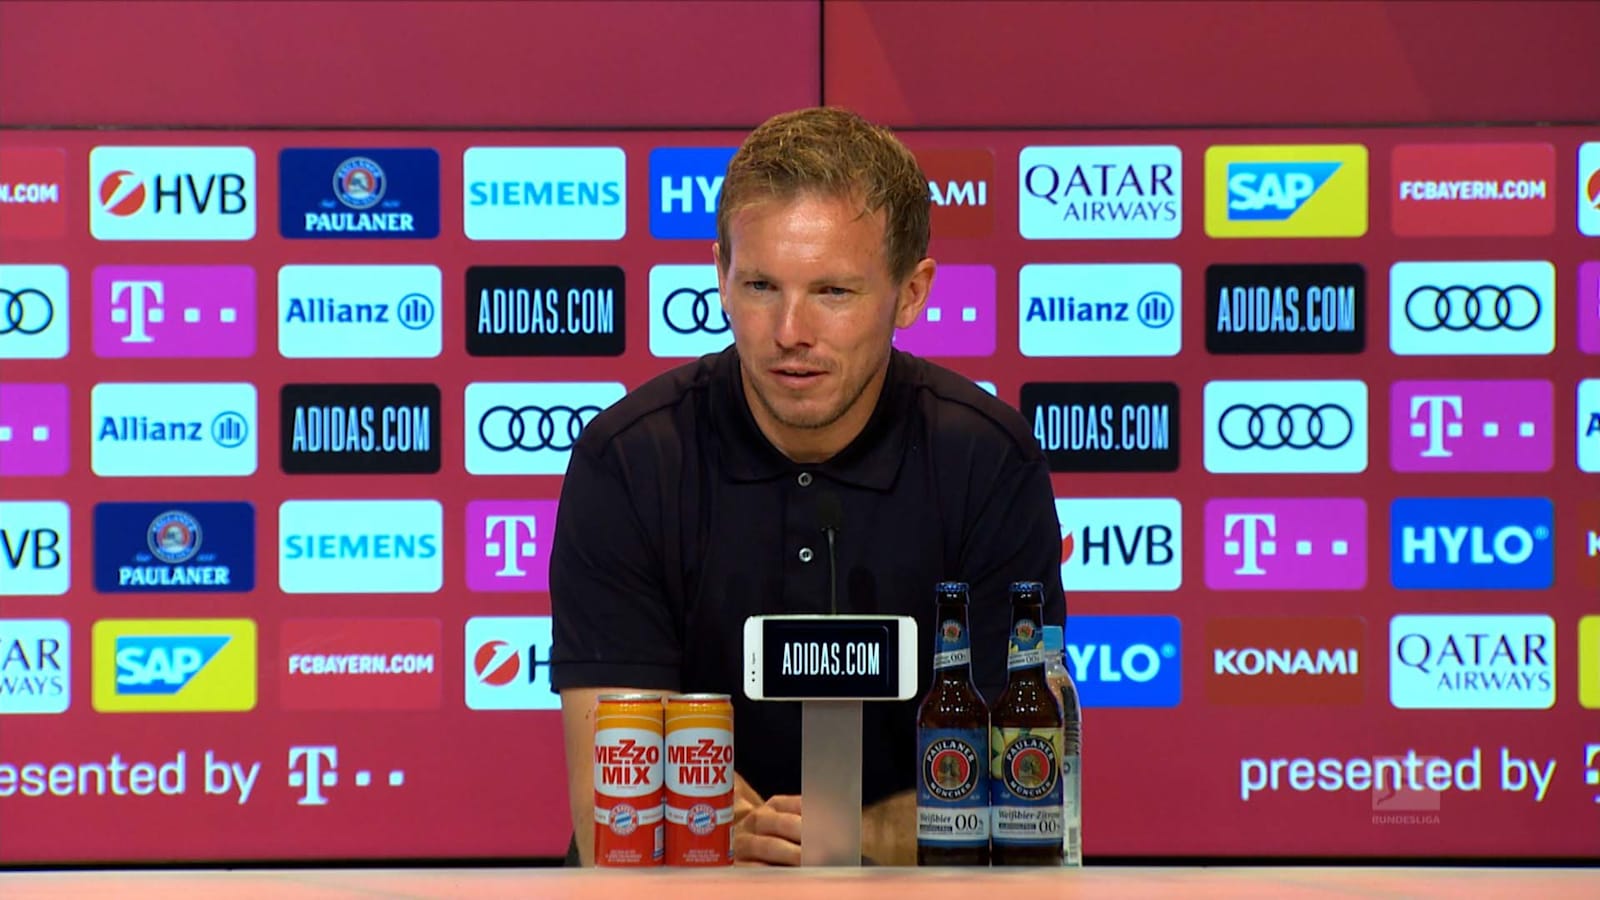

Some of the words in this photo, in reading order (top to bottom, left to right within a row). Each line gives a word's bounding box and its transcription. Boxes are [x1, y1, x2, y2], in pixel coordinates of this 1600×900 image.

[154, 174, 247, 214] HVB
[470, 181, 621, 206] SIEMENS
[661, 176, 724, 213] HY
[928, 181, 987, 205] AMI
[1025, 164, 1175, 204] QATAR
[1228, 173, 1315, 210] SAP
[1400, 180, 1546, 200] FCBAYERN.COM
[304, 212, 415, 231] PAULANER
[1063, 202, 1177, 221] AIRWAYS
[286, 298, 389, 323] Allianz
[477, 288, 614, 334] ADIDAS.COM
[1026, 297, 1129, 322] Allianz
[1217, 286, 1355, 332] ADIDAS.COM
[99, 416, 203, 441] Allianz
[292, 406, 430, 452] ADIDAS.COM
[1034, 405, 1169, 450] ADIDAS.COM
[0, 528, 61, 569] VB
[285, 534, 437, 559] SIEMENS
[1082, 525, 1174, 565] HVB
[1402, 525, 1534, 564] HYLO
[119, 566, 230, 586] PAULANER
[116, 647, 202, 685] SAP
[288, 654, 434, 675] FCBAYERN.COM
[782, 642, 880, 676] ADIDAS.COM
[1065, 644, 1161, 683] YLO
[1214, 648, 1358, 675] KONAMI
[1397, 633, 1548, 673] QATAR
[0, 675, 64, 696] WAYS
[1437, 672, 1550, 691] AIRWAYS
[595, 739, 659, 765] MEZZO
[668, 739, 733, 765] MEZZO
[927, 740, 974, 762] PAULANER
[1006, 739, 1054, 761] PAULANER
[0, 750, 187, 796] esented
[204, 750, 261, 805] by
[1240, 747, 1481, 801] presented
[1501, 747, 1556, 802] by
